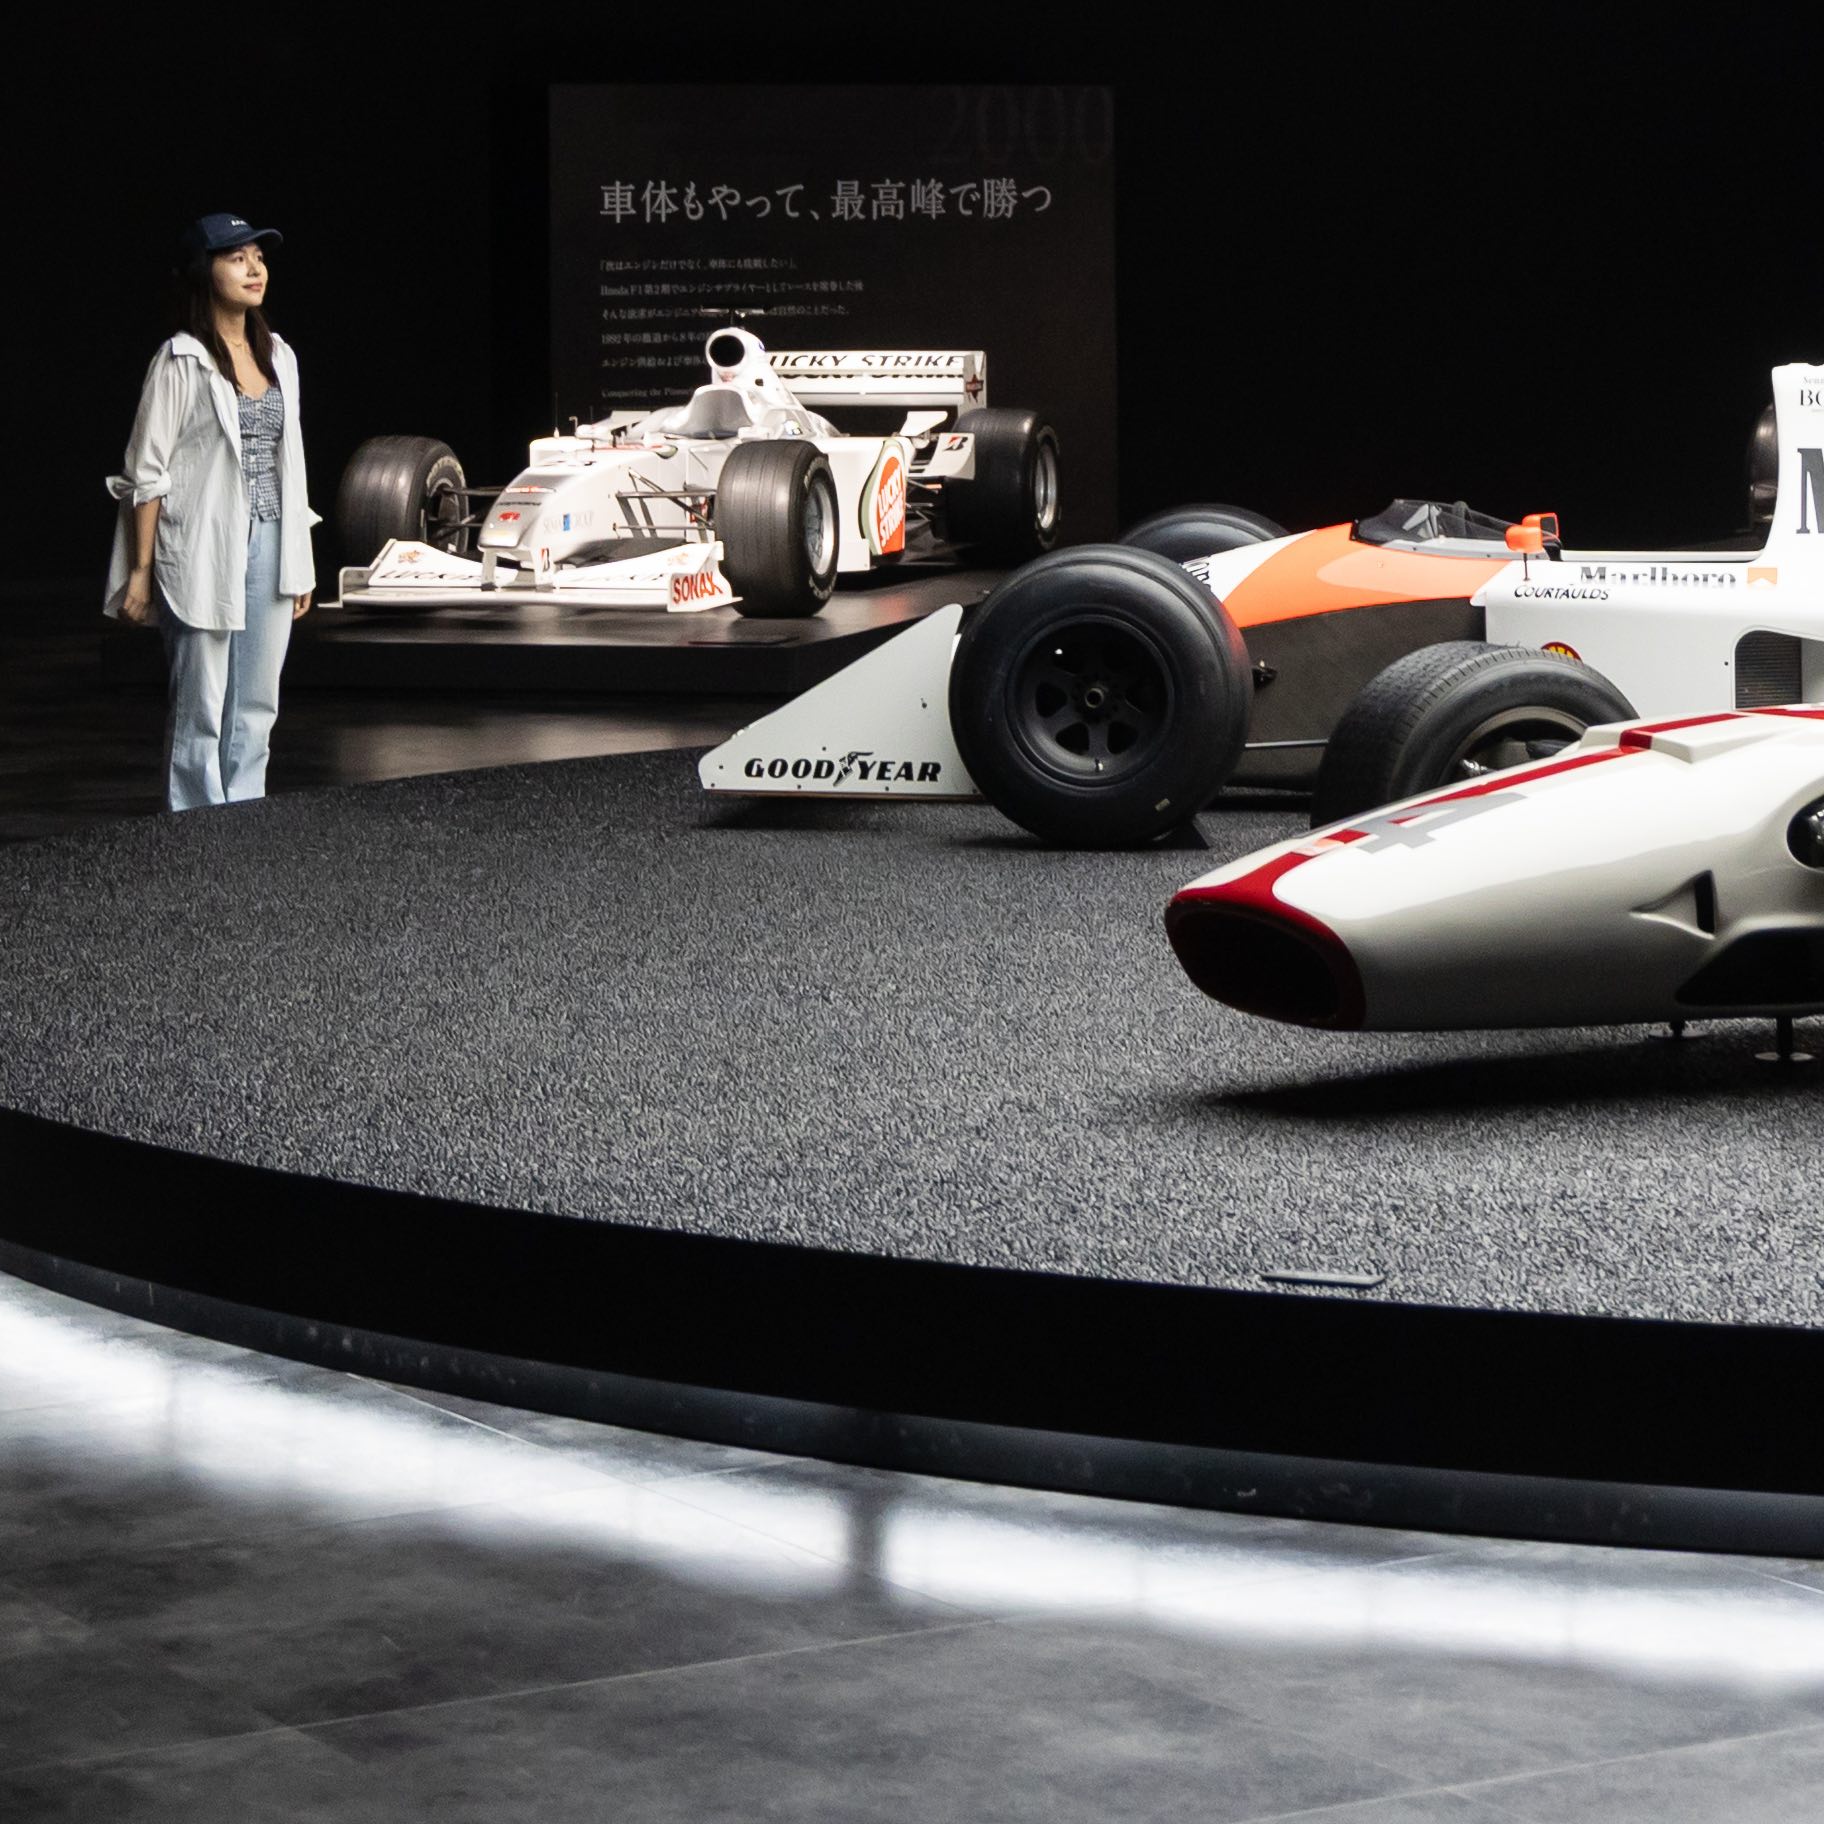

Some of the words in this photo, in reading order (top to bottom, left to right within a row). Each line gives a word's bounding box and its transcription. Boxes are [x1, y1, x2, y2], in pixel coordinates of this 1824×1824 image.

[600, 177, 1052, 224] 車体もやって、最高峰で勝つ
[672, 570, 723, 605] SONAX
[1579, 564, 1737, 588] Marlboro
[1514, 583, 1611, 601] COURTAULDS
[743, 757, 836, 781] GOOD
[857, 760, 942, 783] YEAR
